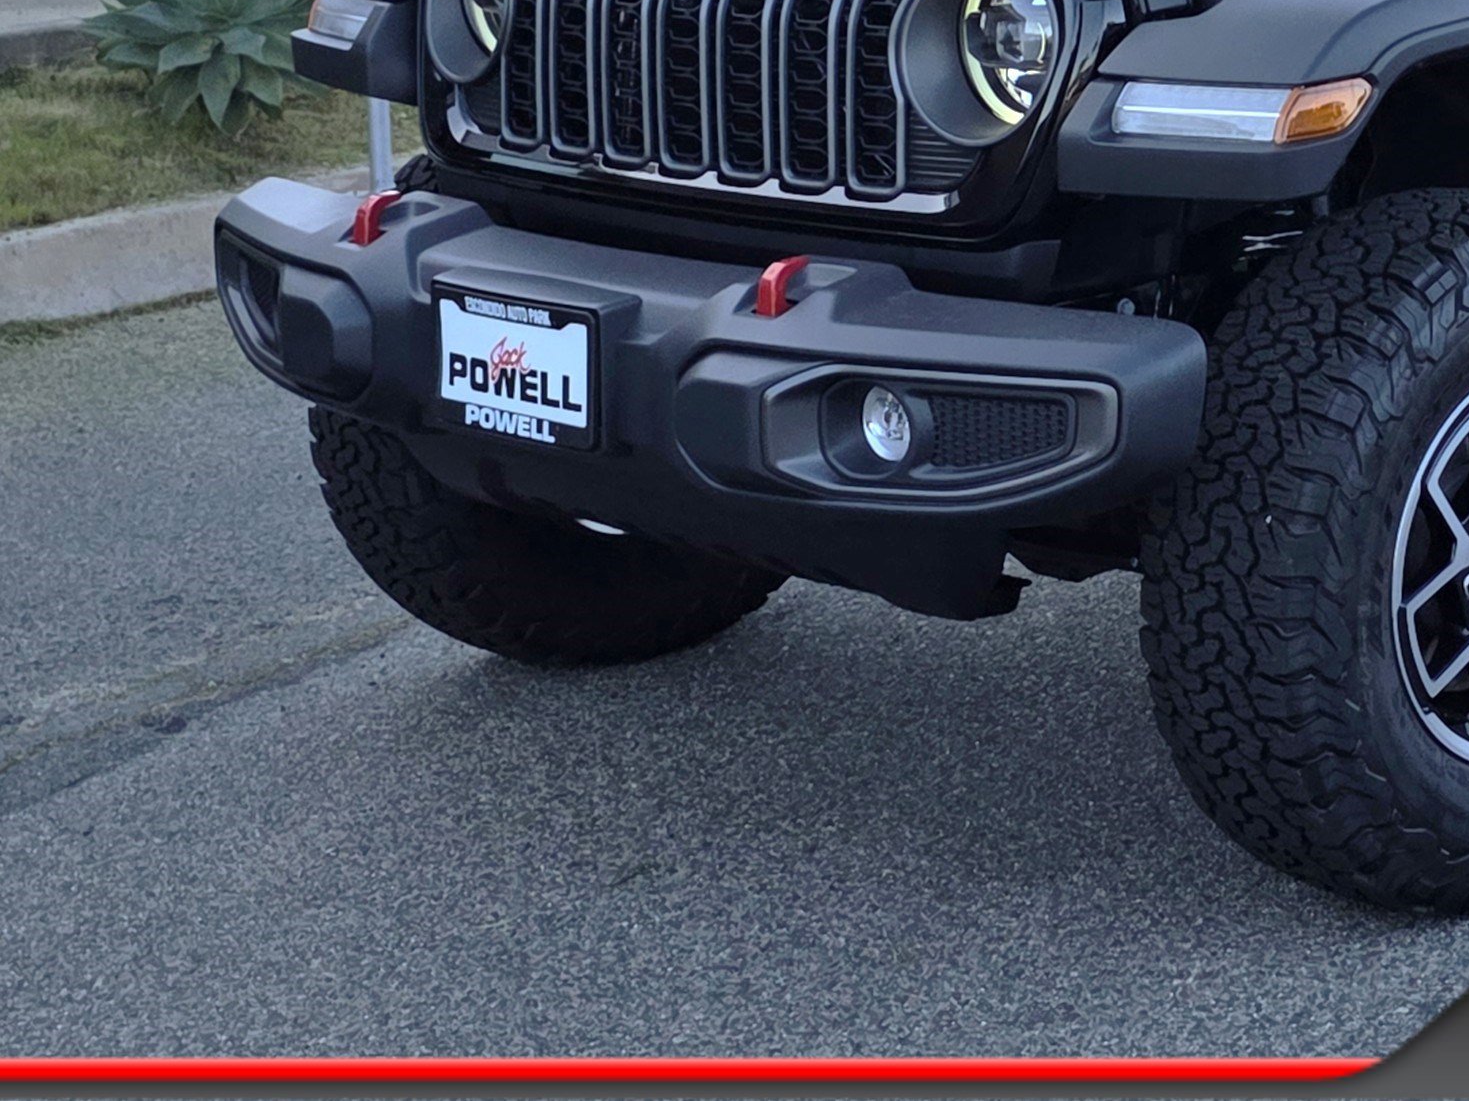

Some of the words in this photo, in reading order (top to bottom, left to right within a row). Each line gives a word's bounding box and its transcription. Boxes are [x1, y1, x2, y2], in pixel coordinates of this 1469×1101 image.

[490, 336, 531, 381] Jack
[449, 352, 582, 412] POWELL
[465, 404, 556, 444] POWELL
